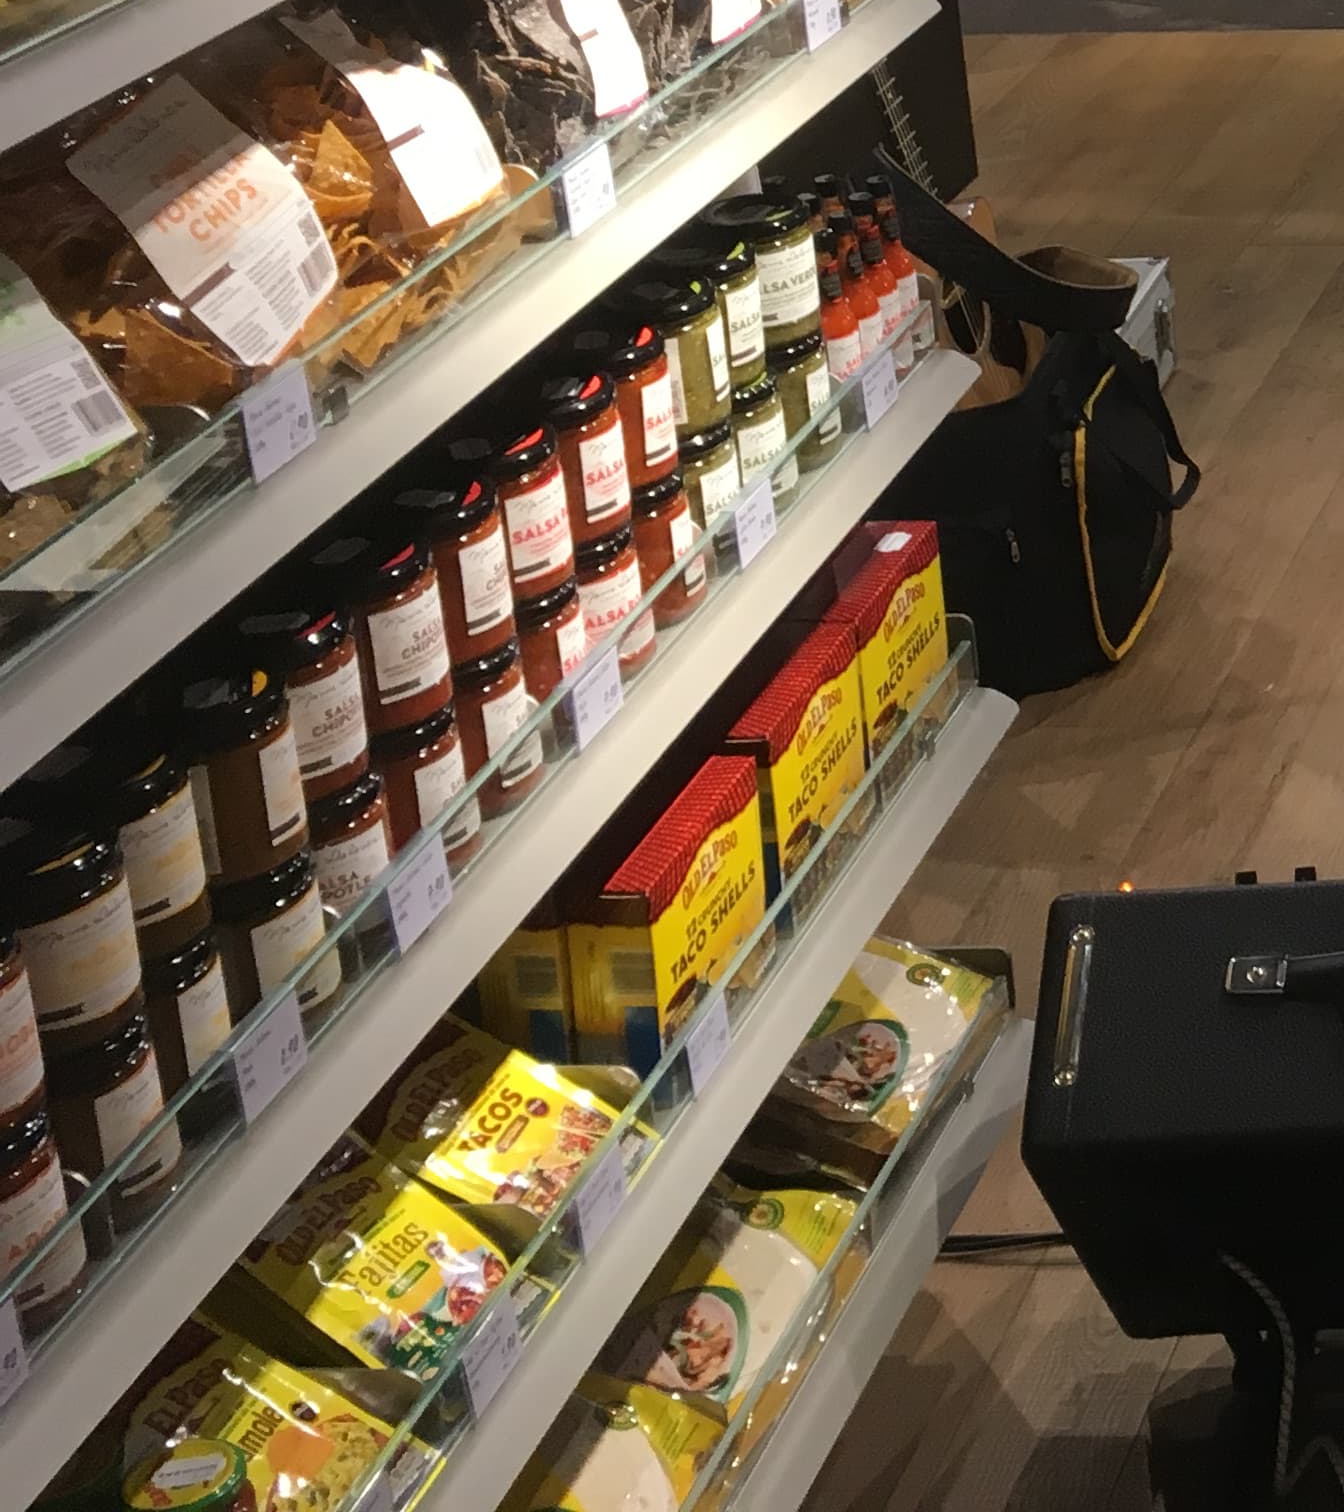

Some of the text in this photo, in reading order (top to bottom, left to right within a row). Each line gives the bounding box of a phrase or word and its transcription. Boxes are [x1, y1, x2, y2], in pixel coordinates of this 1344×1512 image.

[189, 177, 257, 242] CHIPS
[512, 515, 561, 545] SALSA
[876, 611, 940, 705] TACO SHELLS
[788, 717, 857, 824] TACO SHELLS
[670, 859, 756, 984] TACO SHELLS
[456, 1086, 524, 1153] TACOS
[336, 1221, 430, 1296] Fajitas
